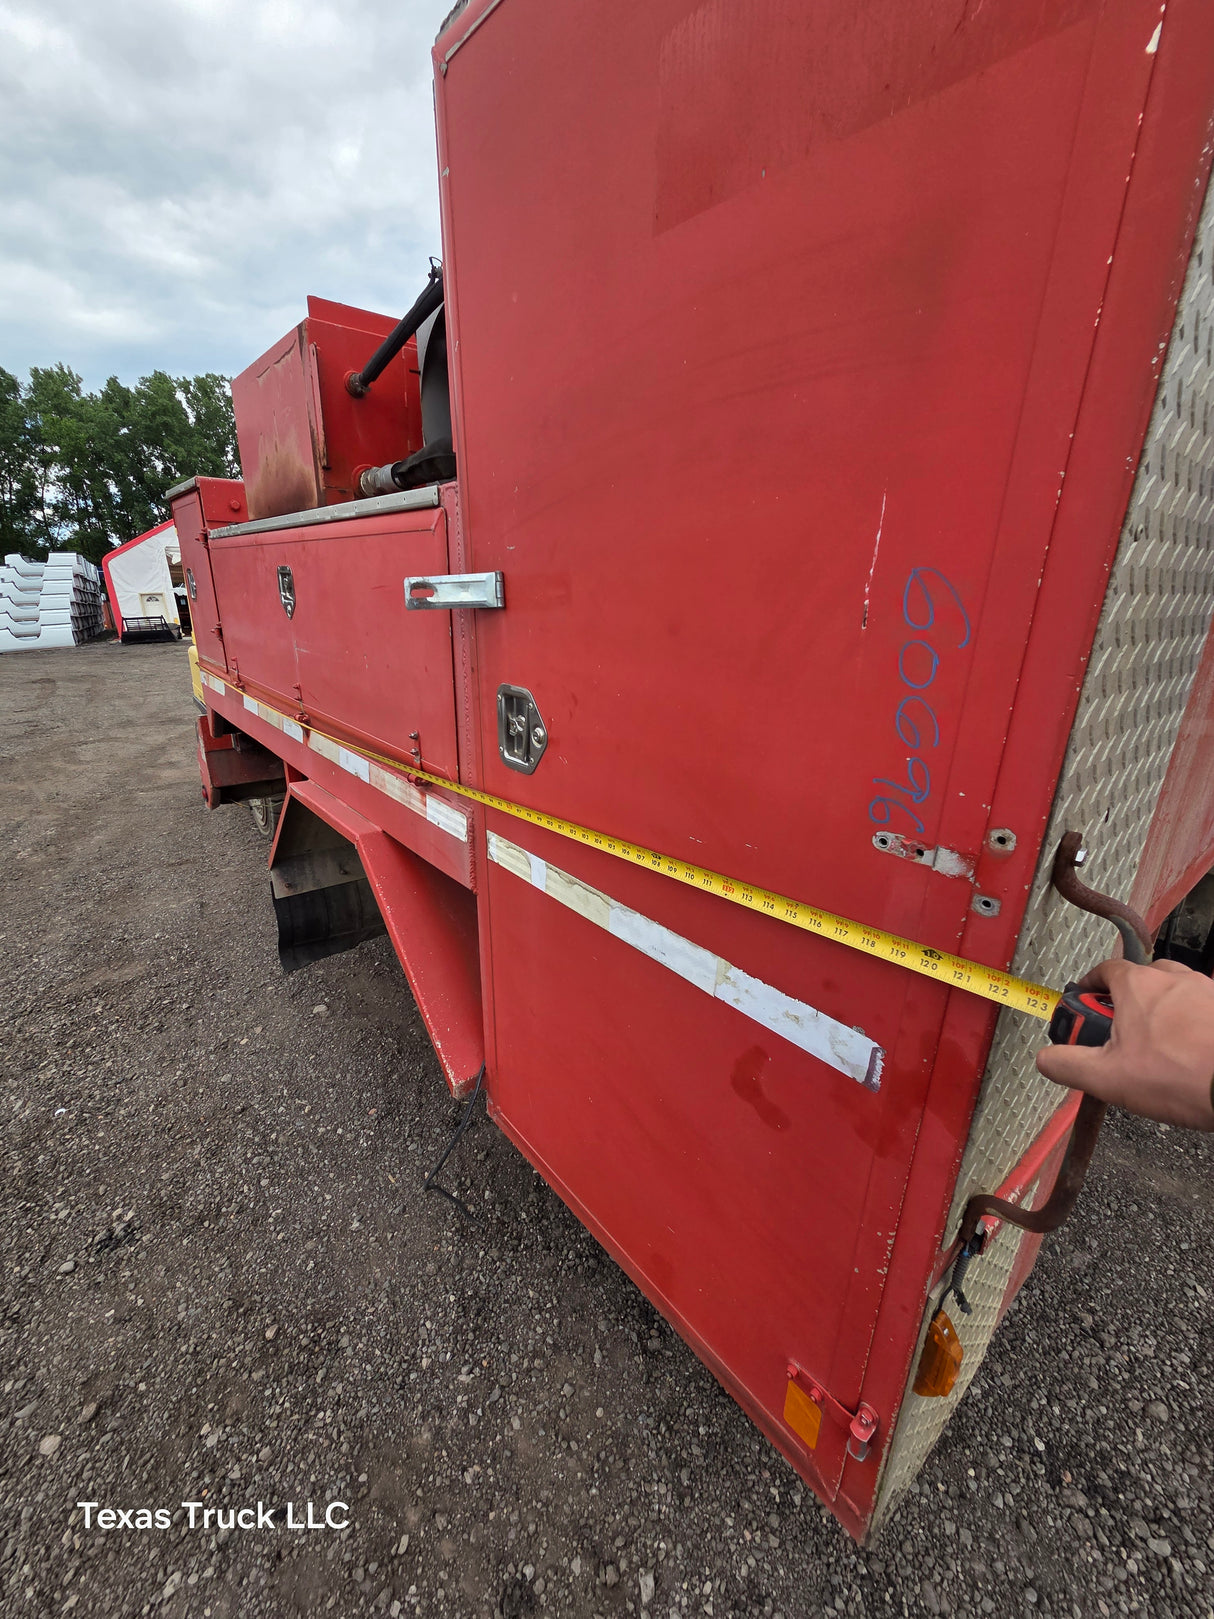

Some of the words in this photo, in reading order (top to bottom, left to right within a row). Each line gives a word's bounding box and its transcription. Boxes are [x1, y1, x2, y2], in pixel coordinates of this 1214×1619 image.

[621, 848, 630, 856] 106
[636, 853, 645, 861] 107
[651, 859, 661, 867] 108
[667, 865, 677, 873] 109
[685, 872, 694, 880] 110
[702, 878, 712, 886] 111
[741, 892, 753, 902] 113
[763, 901, 775, 910] 114
[785, 909, 798, 919] 115
[809, 918, 822, 928] 116
[834, 927, 848, 937] 117
[861, 937, 876, 948] 118
[890, 947, 906, 958] 119
[920, 958, 938, 971] 120
[953, 970, 971, 983] 121
[988, 983, 1009, 998] 122
[1027, 997, 1048, 1012] 123
